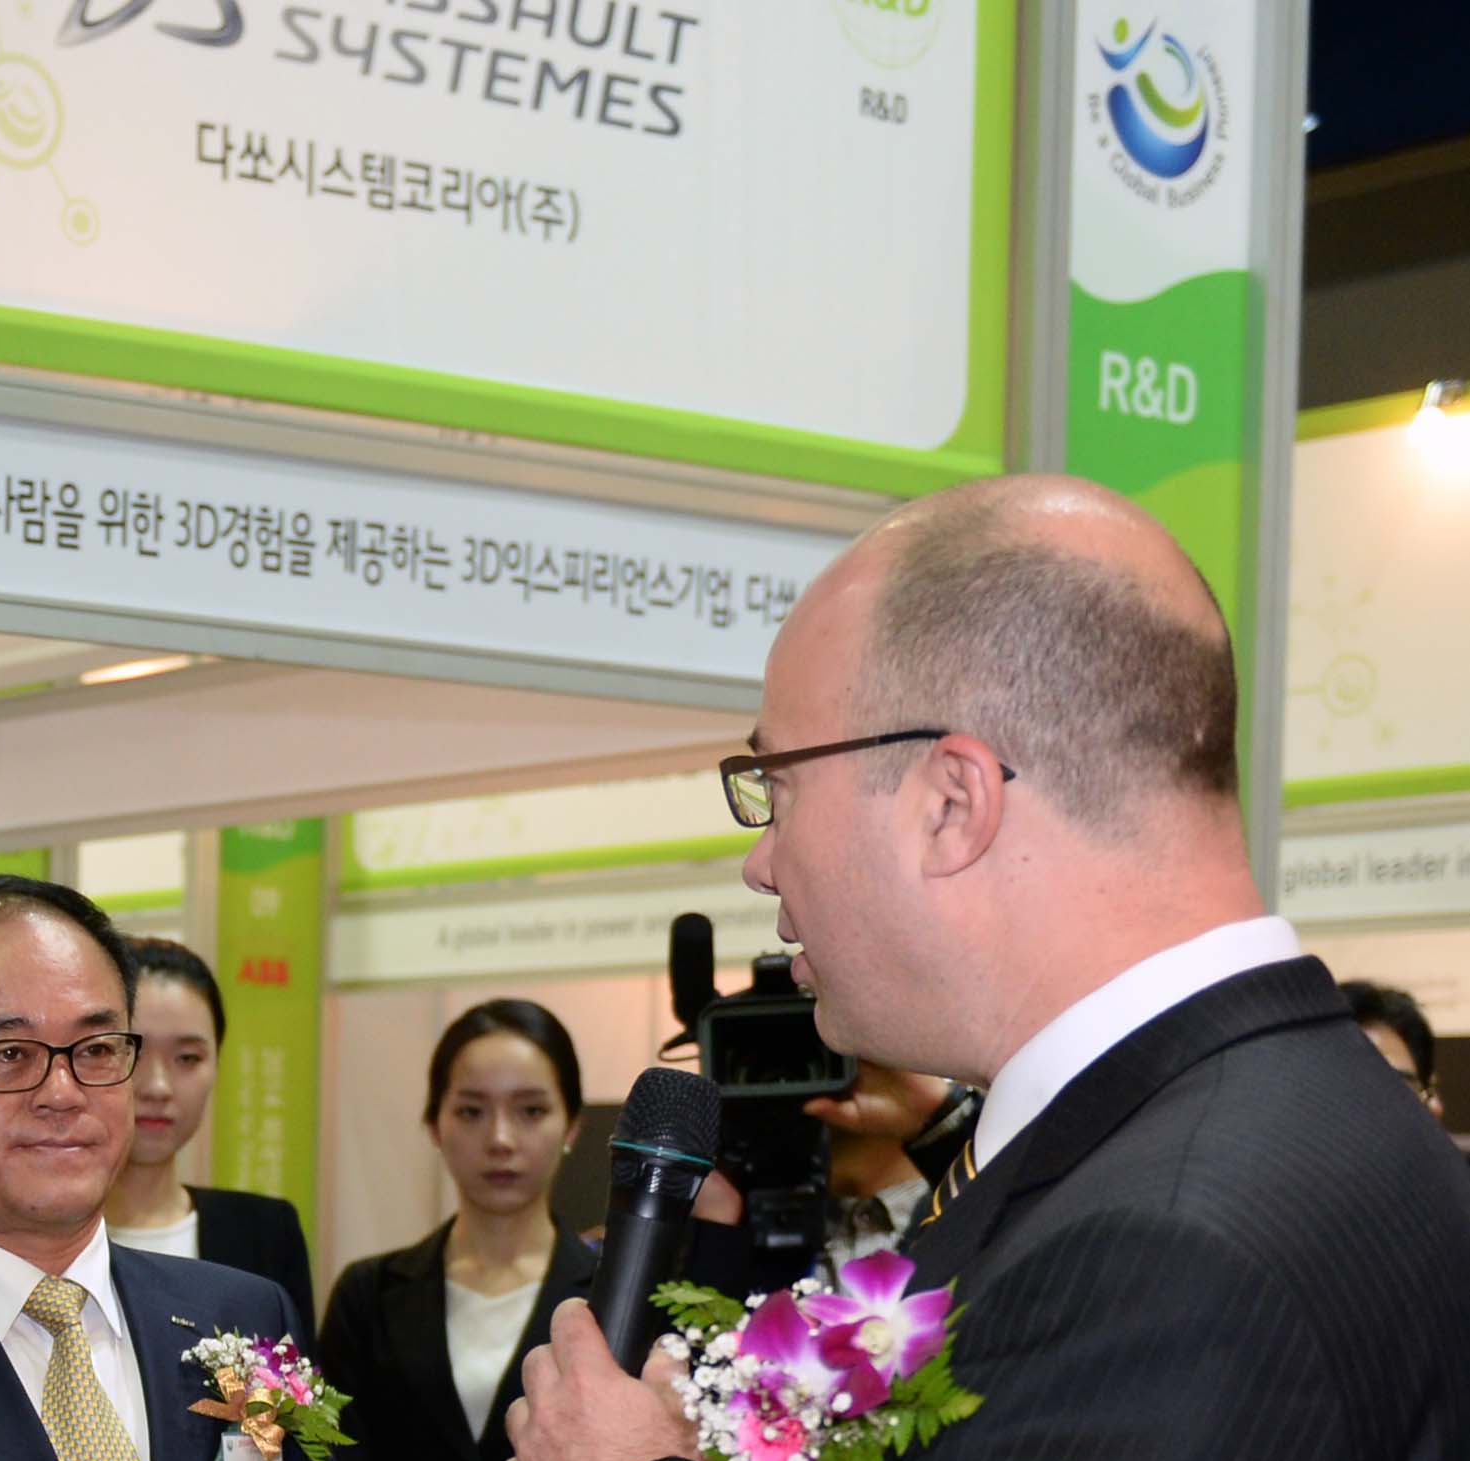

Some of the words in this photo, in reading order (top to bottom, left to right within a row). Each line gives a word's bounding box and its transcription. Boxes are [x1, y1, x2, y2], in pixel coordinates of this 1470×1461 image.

[274, 9, 686, 138] SYSTEMES
[859, 85, 910, 124] R&D
[195, 120, 581, 244] 다쏘시스템코리아(주)
[1098, 350, 1198, 425] R&D
[95, 486, 165, 558] 위한
[174, 500, 317, 577] 3D경험을
[324, 517, 453, 592] 제공하는
[1284, 852, 1359, 896] global
[1365, 850, 1449, 886] leader
[237, 957, 290, 987] ABB
